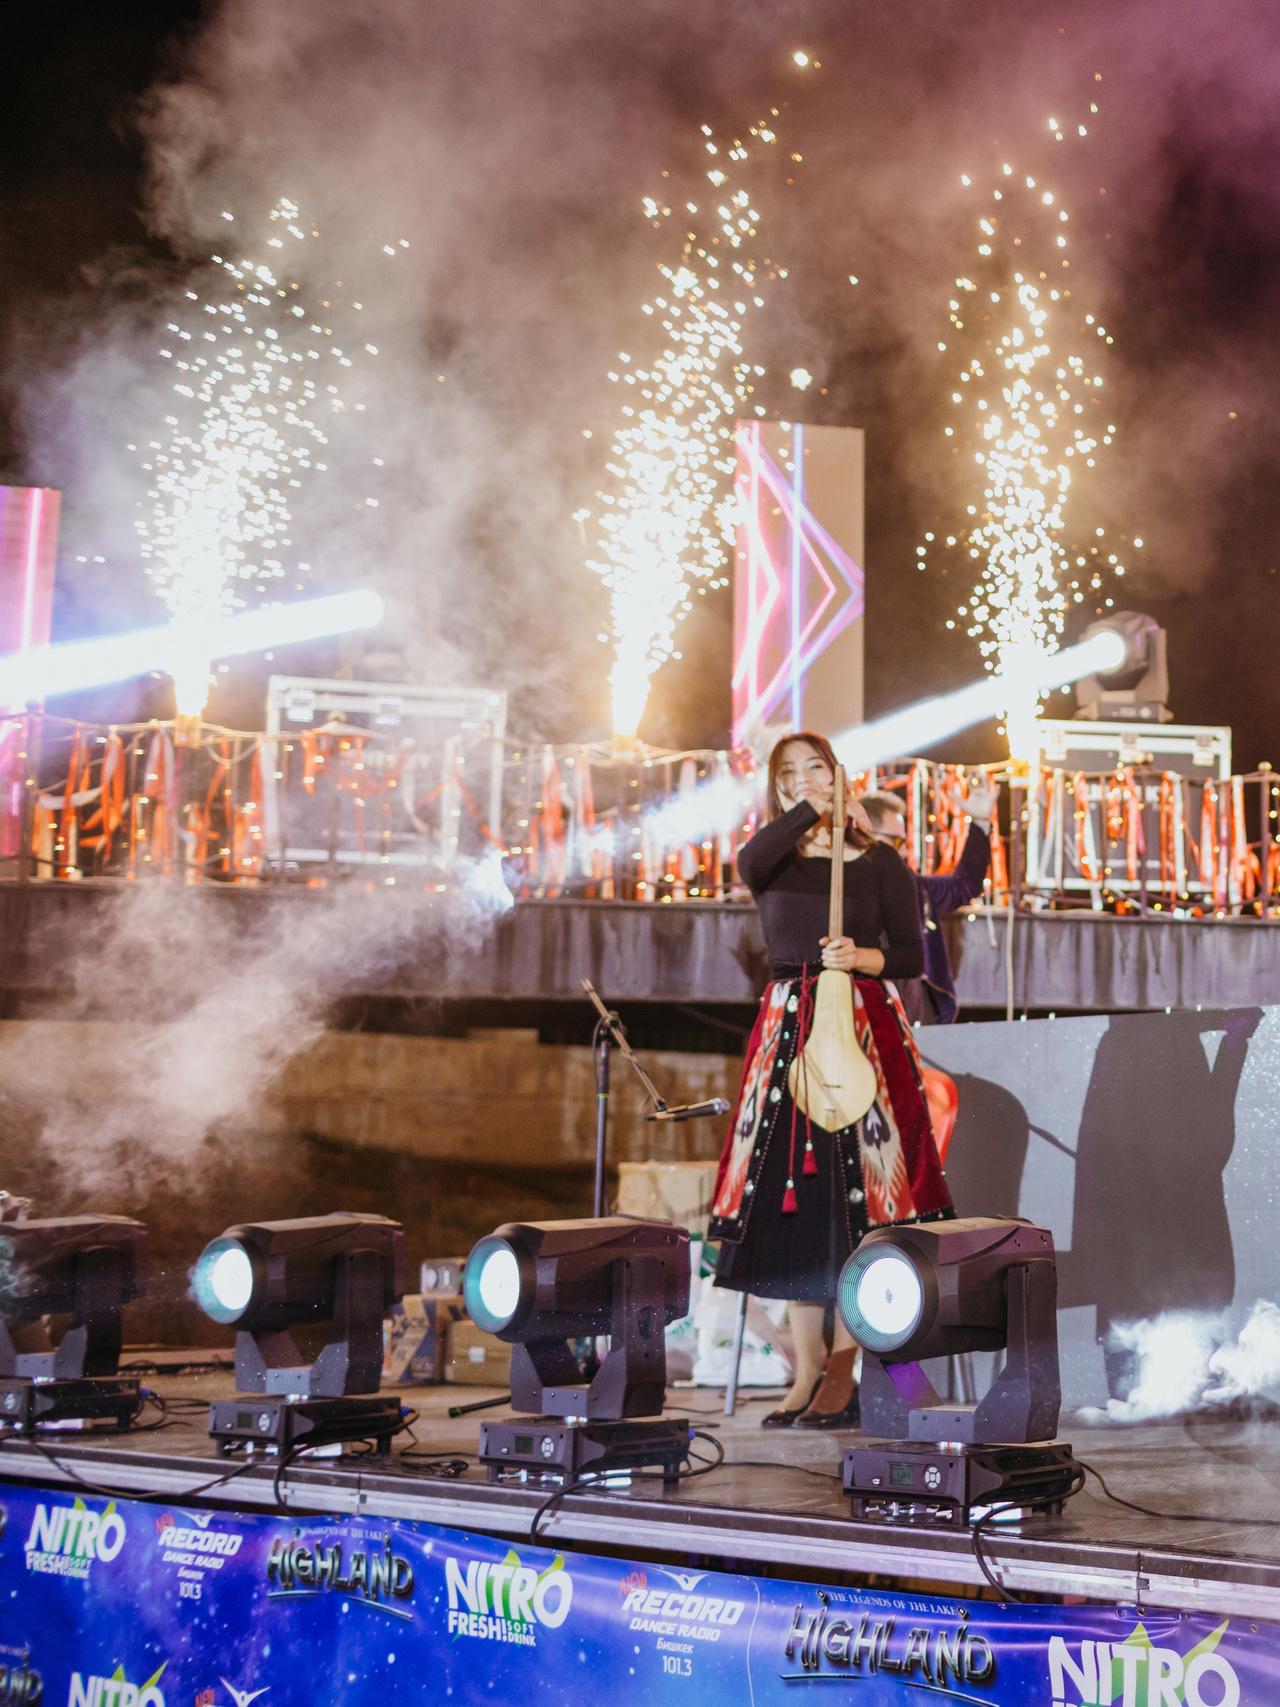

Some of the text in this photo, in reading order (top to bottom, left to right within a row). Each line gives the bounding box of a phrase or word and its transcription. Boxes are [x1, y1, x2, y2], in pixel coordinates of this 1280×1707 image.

[24, 1503, 126, 1563] NITRO
[158, 1526, 243, 1556] RECORD
[26, 1551, 70, 1577] FRESH!
[162, 1551, 225, 1569] DANCE RADIO
[268, 1534, 415, 1600] HIGHLAND
[445, 1557, 574, 1629] NITRO
[619, 1571, 648, 1598] NEW
[621, 1588, 745, 1626] RECORD
[828, 1591, 958, 1616] THE LEGENDS OF THE LAKE
[448, 1610, 507, 1642] FRESH!
[506, 1620, 534, 1635] SOFT
[629, 1617, 722, 1642] DANCE RADIO
[507, 1633, 536, 1647] DRINK
[656, 1637, 695, 1654] Бишкек
[784, 1602, 995, 1686] HIGHLAND
[662, 1655, 692, 1677] 101.3
[1048, 1635, 1241, 1707] NITRO
